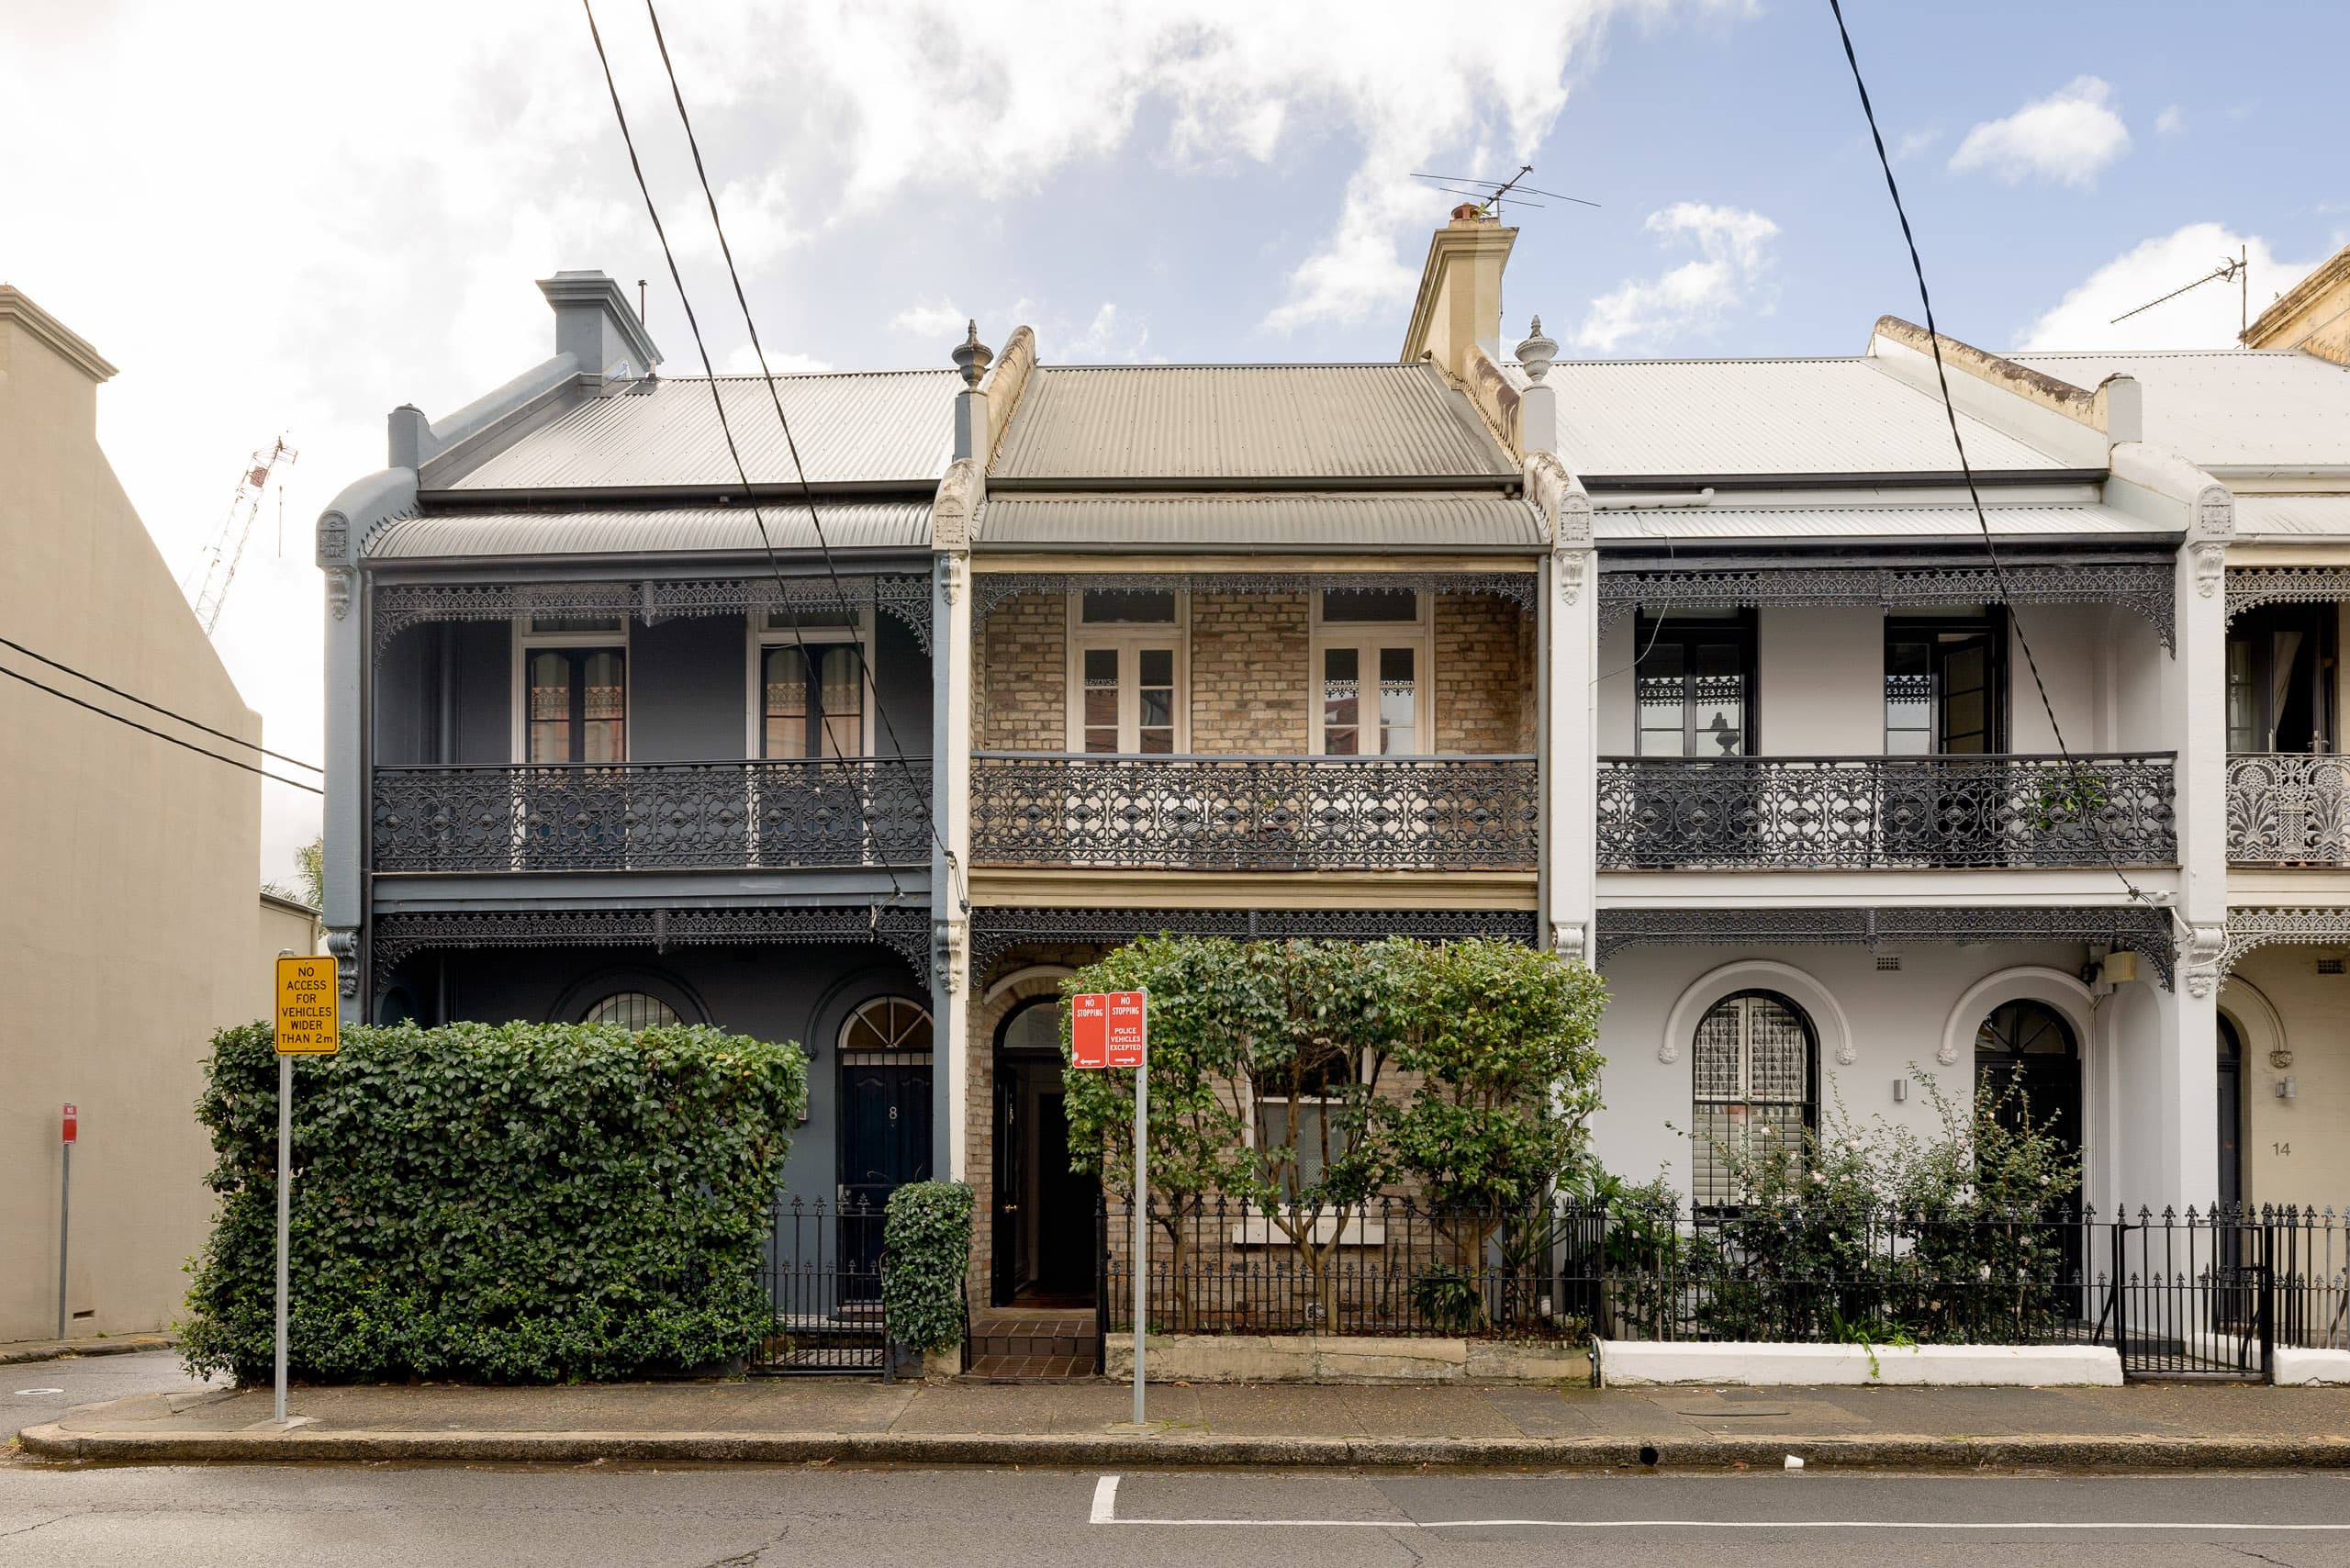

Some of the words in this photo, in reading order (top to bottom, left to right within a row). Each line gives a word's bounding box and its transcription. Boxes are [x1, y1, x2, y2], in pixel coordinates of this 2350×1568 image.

[298, 967, 314, 977] NO
[286, 980, 327, 991] ACCESS
[296, 994, 317, 1003] FOR
[1085, 999, 1094, 1007] NO
[1120, 997, 1130, 1005] NO
[282, 1007, 331, 1017] VEHICLES
[1077, 1009, 1103, 1017] STOPPING
[1112, 1007, 1139, 1015] STOPPING
[290, 1021, 322, 1030] WIDER
[281, 1034, 310, 1043] THAN
[315, 1034, 333, 1043] 2m
[890, 1106, 897, 1119] 8
[2272, 1142, 2291, 1156] 14
